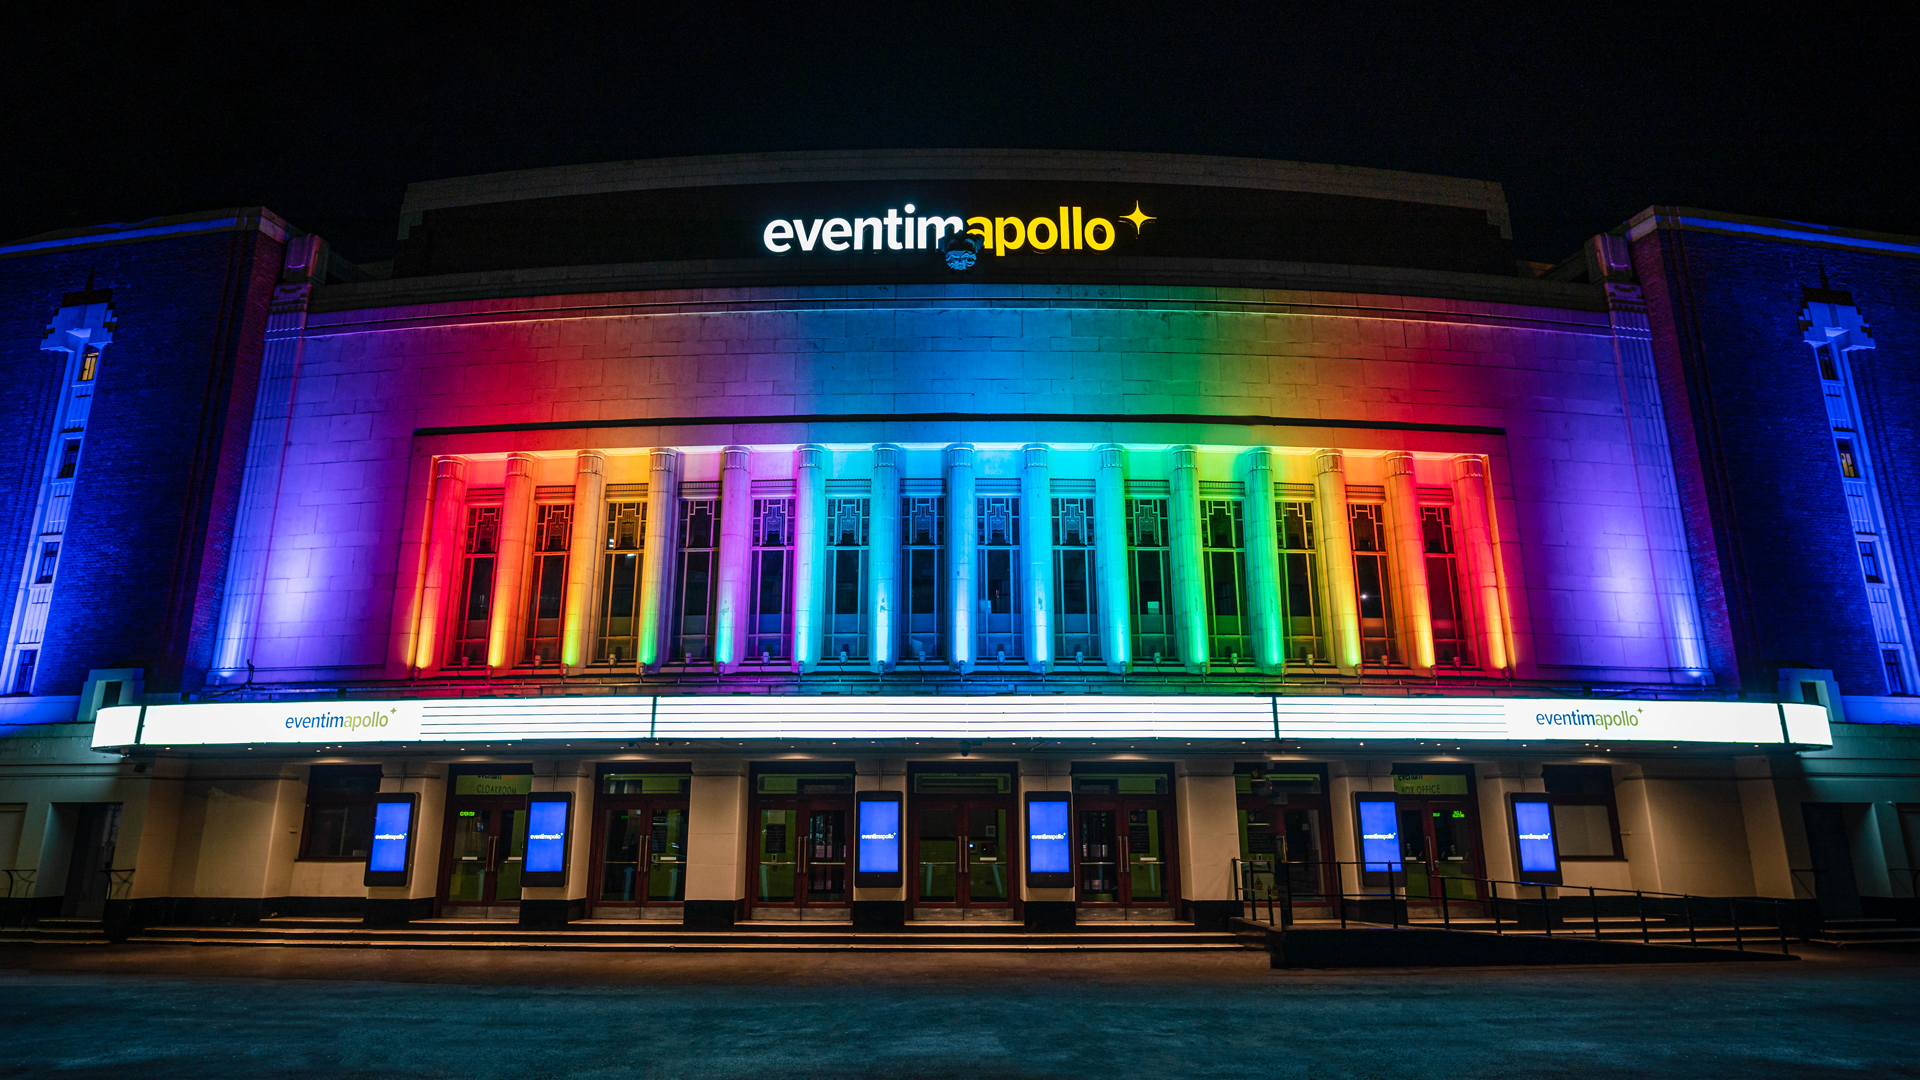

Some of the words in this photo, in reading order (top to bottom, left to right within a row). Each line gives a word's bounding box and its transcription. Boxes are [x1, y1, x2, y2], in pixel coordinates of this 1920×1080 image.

[285, 711, 389, 732] eventimapollo
[1535, 709, 1639, 730] eventimapollo
[476, 784, 517, 795] CLOAKROOM
[1401, 786, 1414, 794] BOX
[1416, 784, 1441, 794] OFFICE
